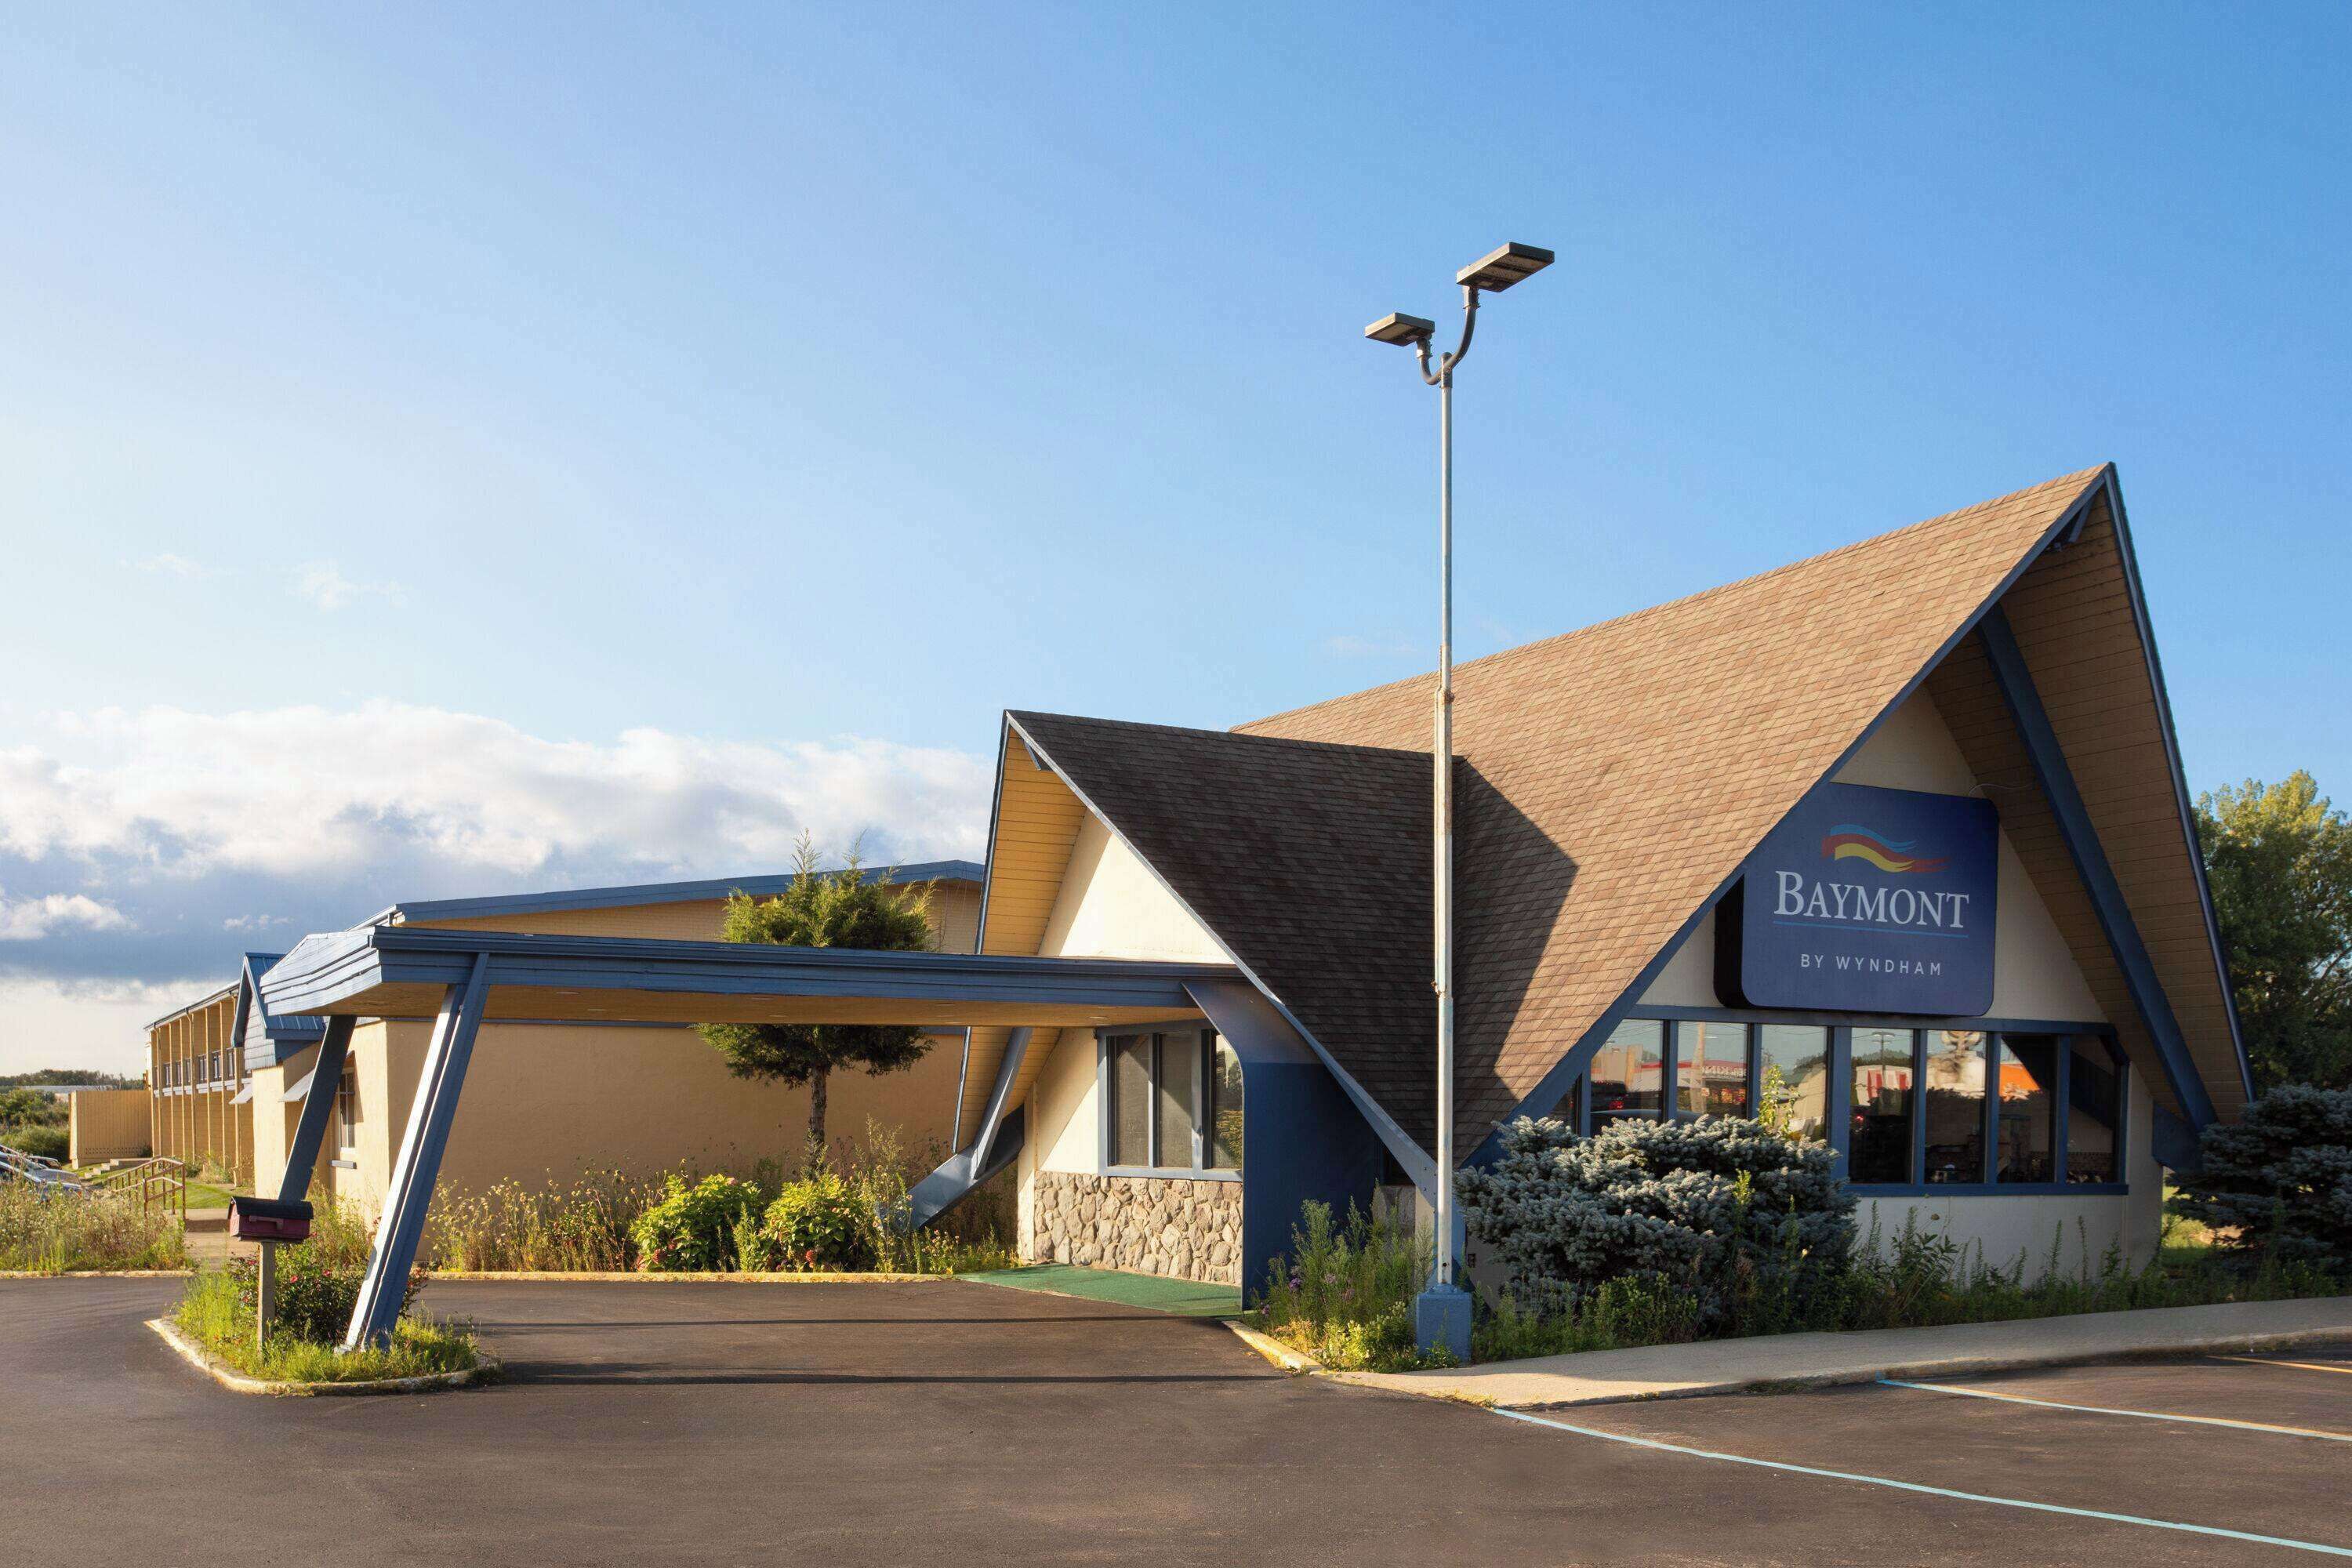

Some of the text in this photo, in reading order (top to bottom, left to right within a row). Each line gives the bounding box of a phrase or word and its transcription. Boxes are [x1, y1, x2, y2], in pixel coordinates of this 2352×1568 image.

[1774, 870, 1969, 928] BAYMONT
[1801, 953, 1940, 975] BY WYNDHAM
